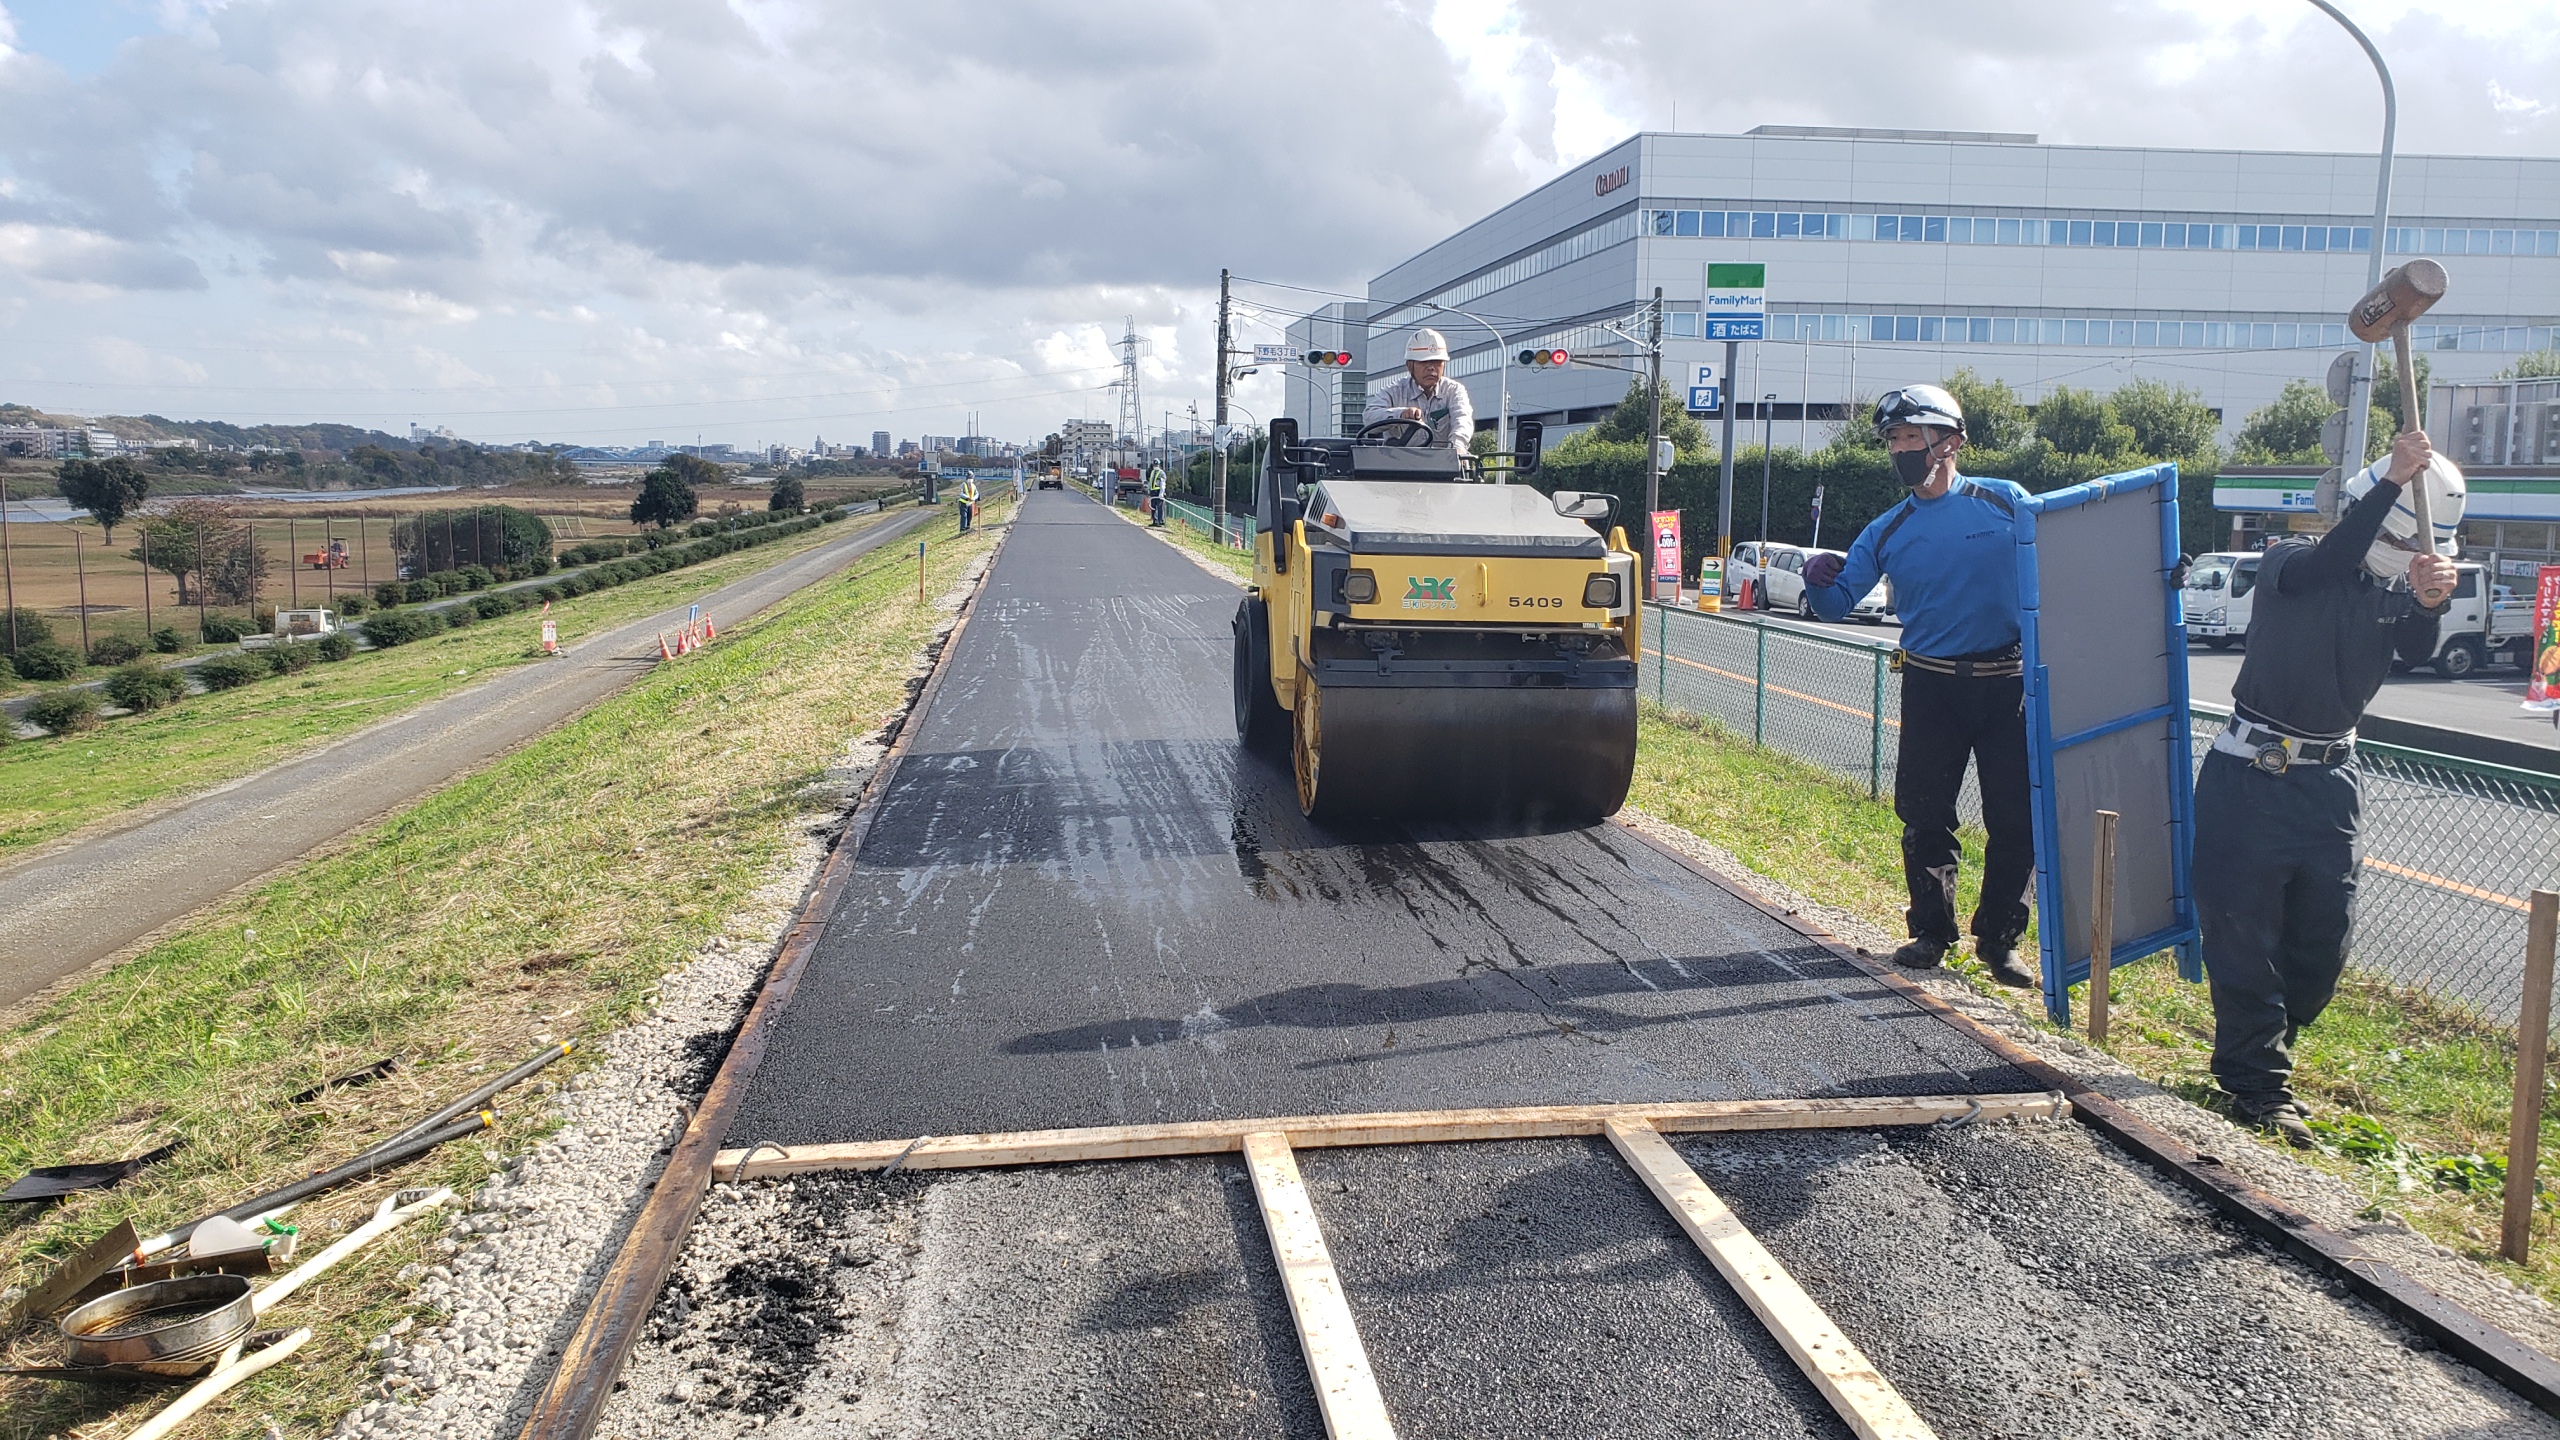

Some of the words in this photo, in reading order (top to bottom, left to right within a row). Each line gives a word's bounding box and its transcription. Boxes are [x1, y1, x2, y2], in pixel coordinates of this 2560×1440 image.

[1708, 295, 1763, 307] FamilyMart
[1712, 322, 1727, 337] 酒
[1730, 324, 1759, 336] たばこ
[1699, 366, 1712, 385] P
[2295, 493, 2316, 506] Fami
[1401, 601, 1458, 610] 三和レンタル
[1508, 597, 1563, 608] 5409
